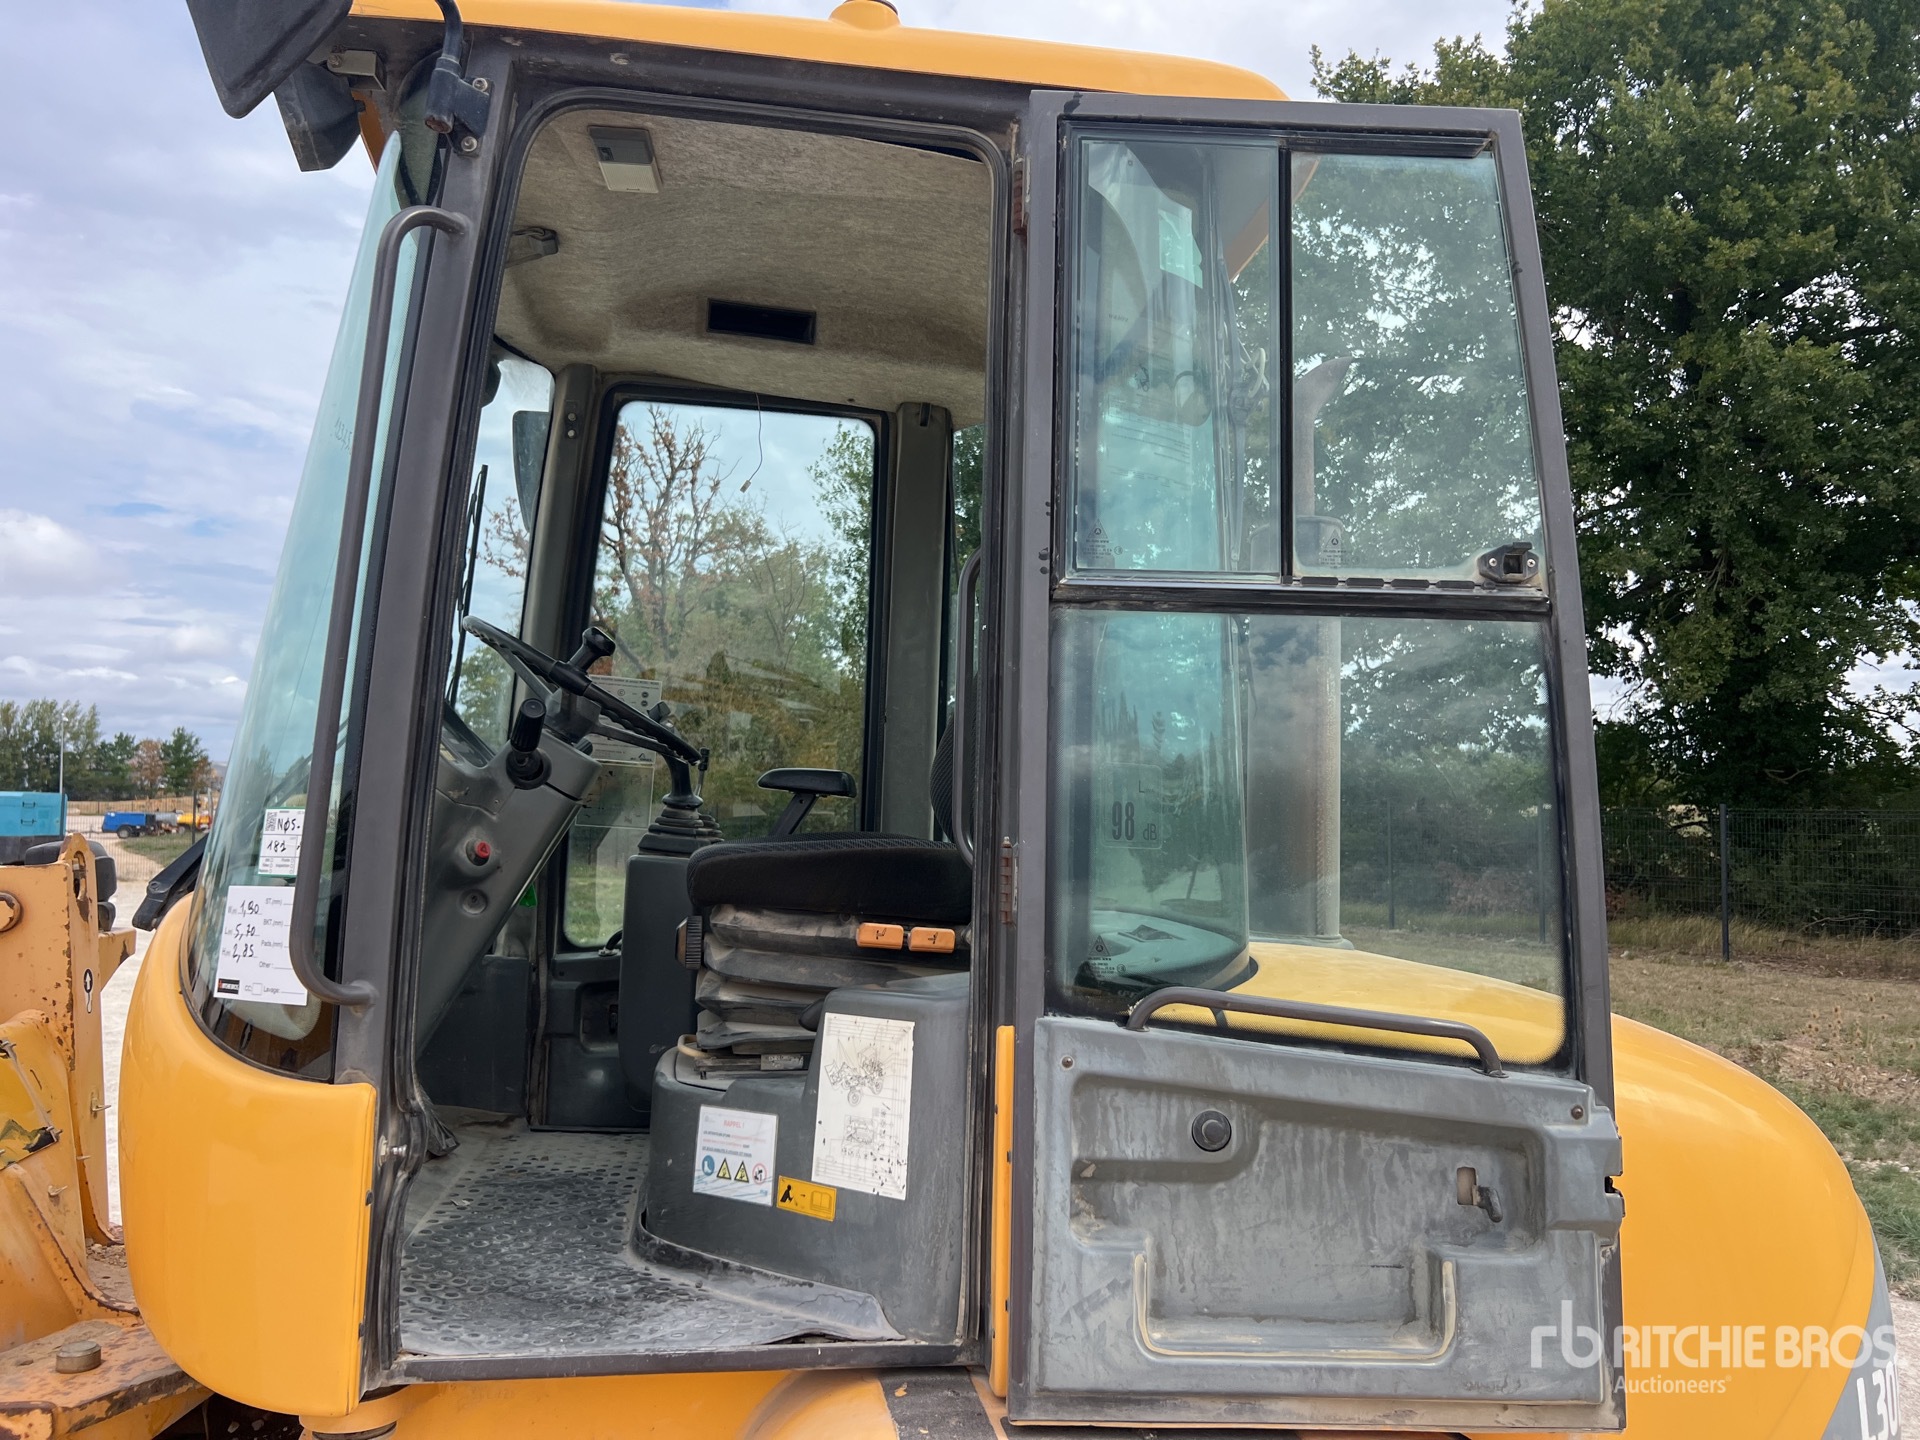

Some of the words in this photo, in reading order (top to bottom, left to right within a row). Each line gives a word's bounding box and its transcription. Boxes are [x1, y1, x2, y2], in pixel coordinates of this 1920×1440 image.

[1111, 801, 1135, 841] 98
[1142, 823, 1158, 841] dB
[232, 943, 254, 963] 2,85
